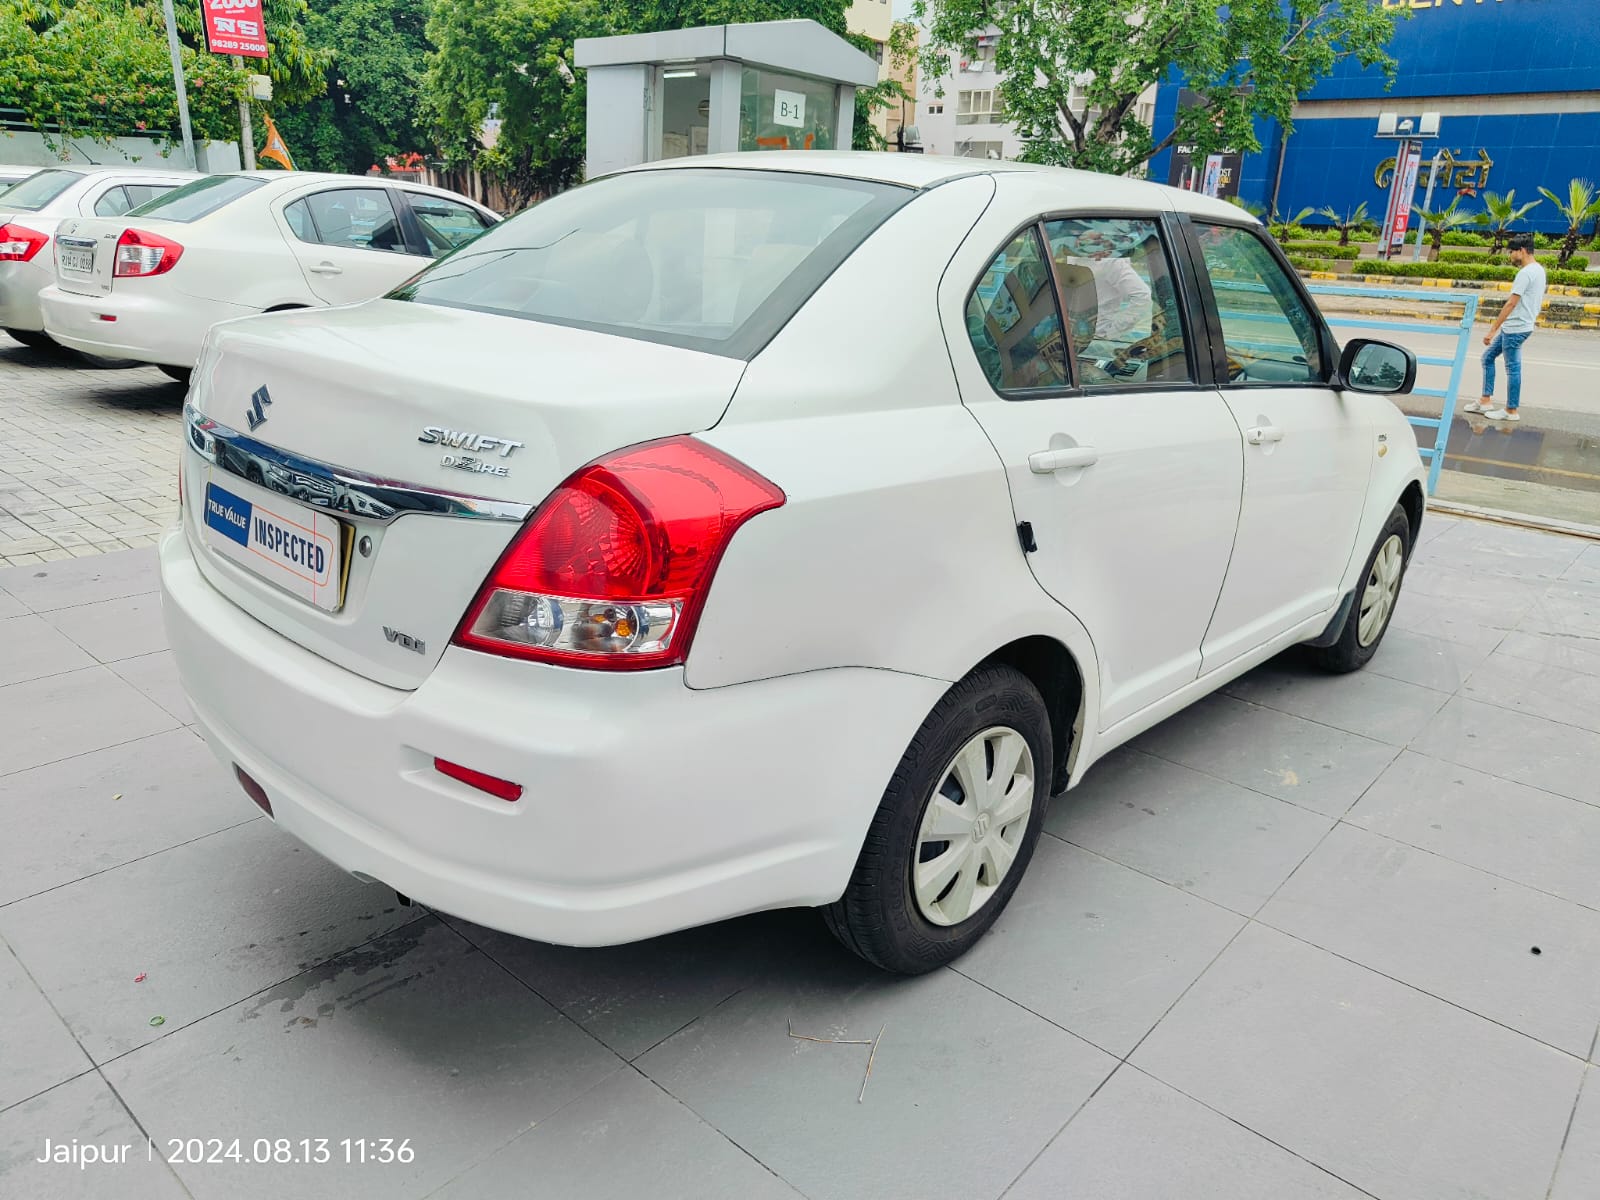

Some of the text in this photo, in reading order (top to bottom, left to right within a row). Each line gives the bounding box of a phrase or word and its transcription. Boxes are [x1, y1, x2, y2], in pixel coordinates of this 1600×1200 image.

[211, 39, 266, 52] 98289 25000
[781, 101, 799, 120] B-1
[418, 426, 525, 457] SWIFT
[440, 455, 511, 477] DZIRE
[208, 498, 247, 529] TRUE VALUE
[254, 515, 324, 574] INSPECTED
